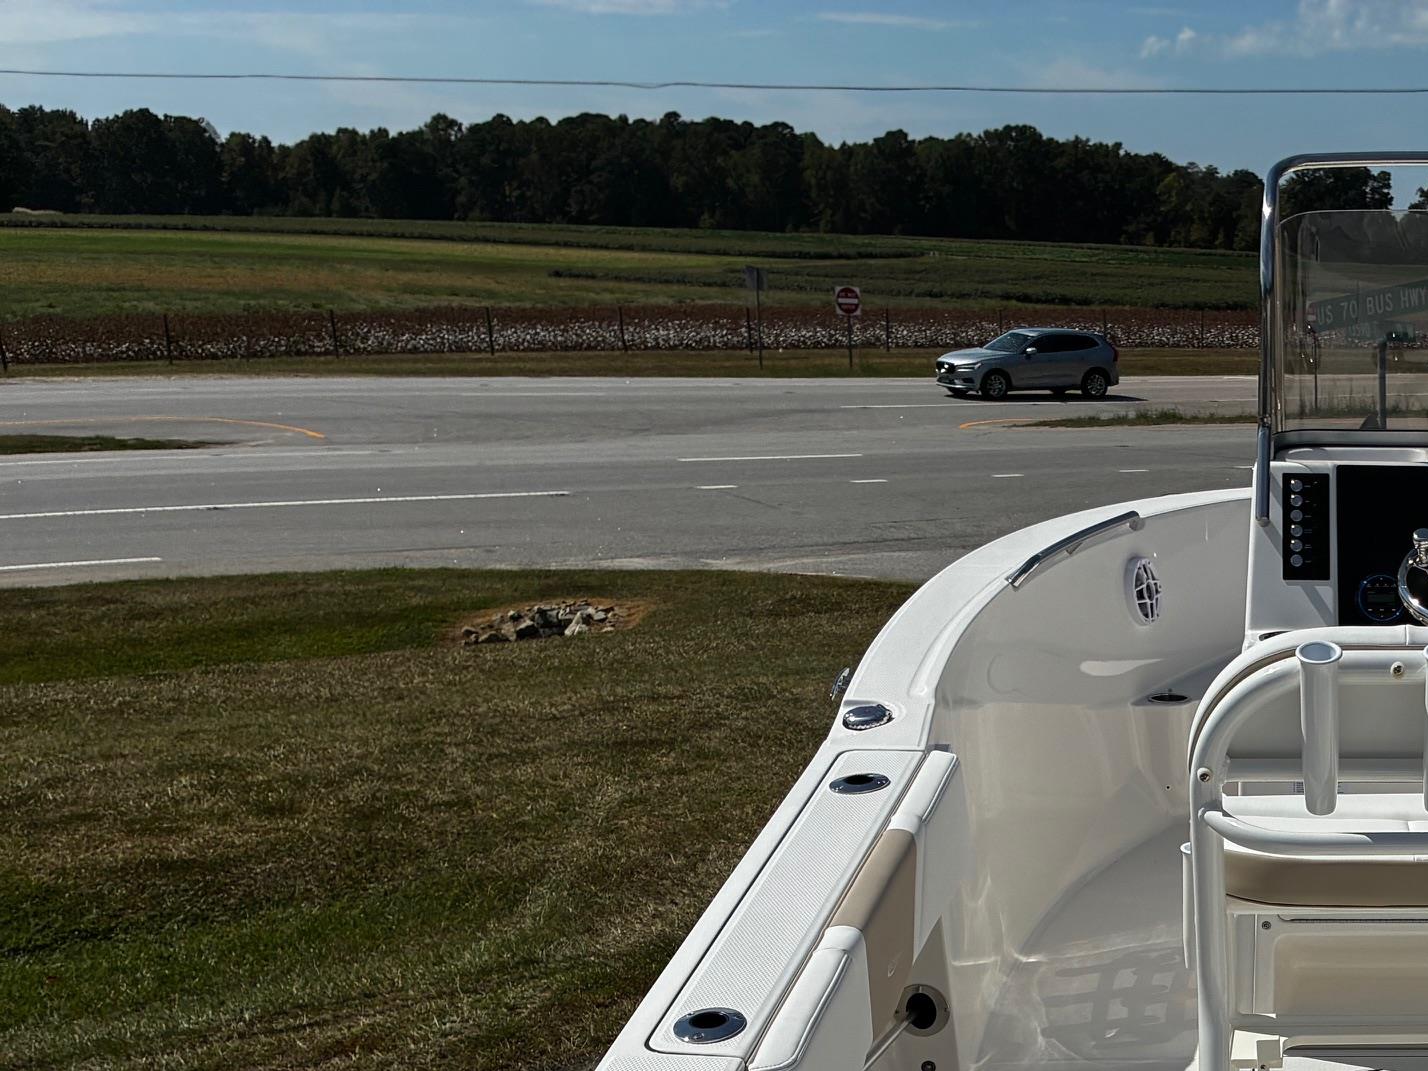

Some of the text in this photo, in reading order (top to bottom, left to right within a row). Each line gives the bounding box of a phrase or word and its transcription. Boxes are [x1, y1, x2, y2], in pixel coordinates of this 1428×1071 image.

[1316, 305, 1334, 325] US
[1340, 301, 1358, 320] 70
[1366, 293, 1393, 315] BUS
[1400, 287, 1427, 308] HWY
